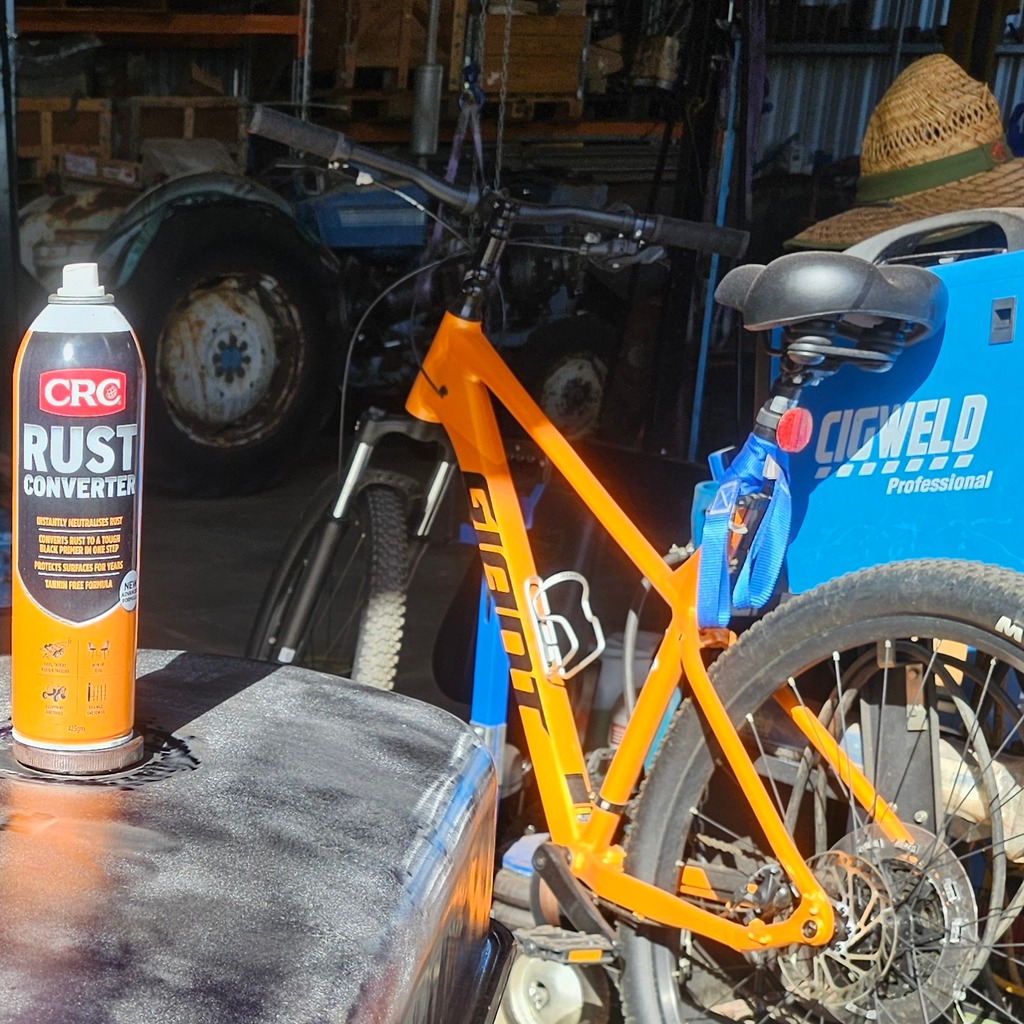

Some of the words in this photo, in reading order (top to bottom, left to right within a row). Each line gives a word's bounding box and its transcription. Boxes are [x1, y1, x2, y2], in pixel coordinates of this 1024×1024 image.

[44, 378, 121, 407] CRC
[814, 394, 988, 464] CIGWELD
[23, 422, 138, 474] RUST
[23, 473, 136, 499] CONVERTER
[886, 470, 994, 495] Professional
[36, 516, 68, 528] INSTANTLY
[68, 517, 109, 528] NEUTRALISES
[109, 516, 124, 525] RUST
[38, 534, 69, 545] CONVERTS
[69, 536, 86, 545] RUST
[86, 536, 95, 545] TO
[95, 536, 101, 545] A
[101, 534, 121, 544] TOUGH
[39, 544, 58, 554] BLACK
[59, 545, 84, 555] PRIMER
[84, 545, 92, 555] IN
[92, 545, 106, 555] ONE
[106, 544, 120, 554] STEP
[34, 560, 62, 571] PROTECTS
[62, 562, 94, 573] SURFACES
[94, 561, 107, 572] FOR
[107, 560, 124, 571] YEARS
[44, 579, 68, 590] TANNIN
[68, 580, 85, 590] FREE
[85, 579, 113, 590] FORMULA
